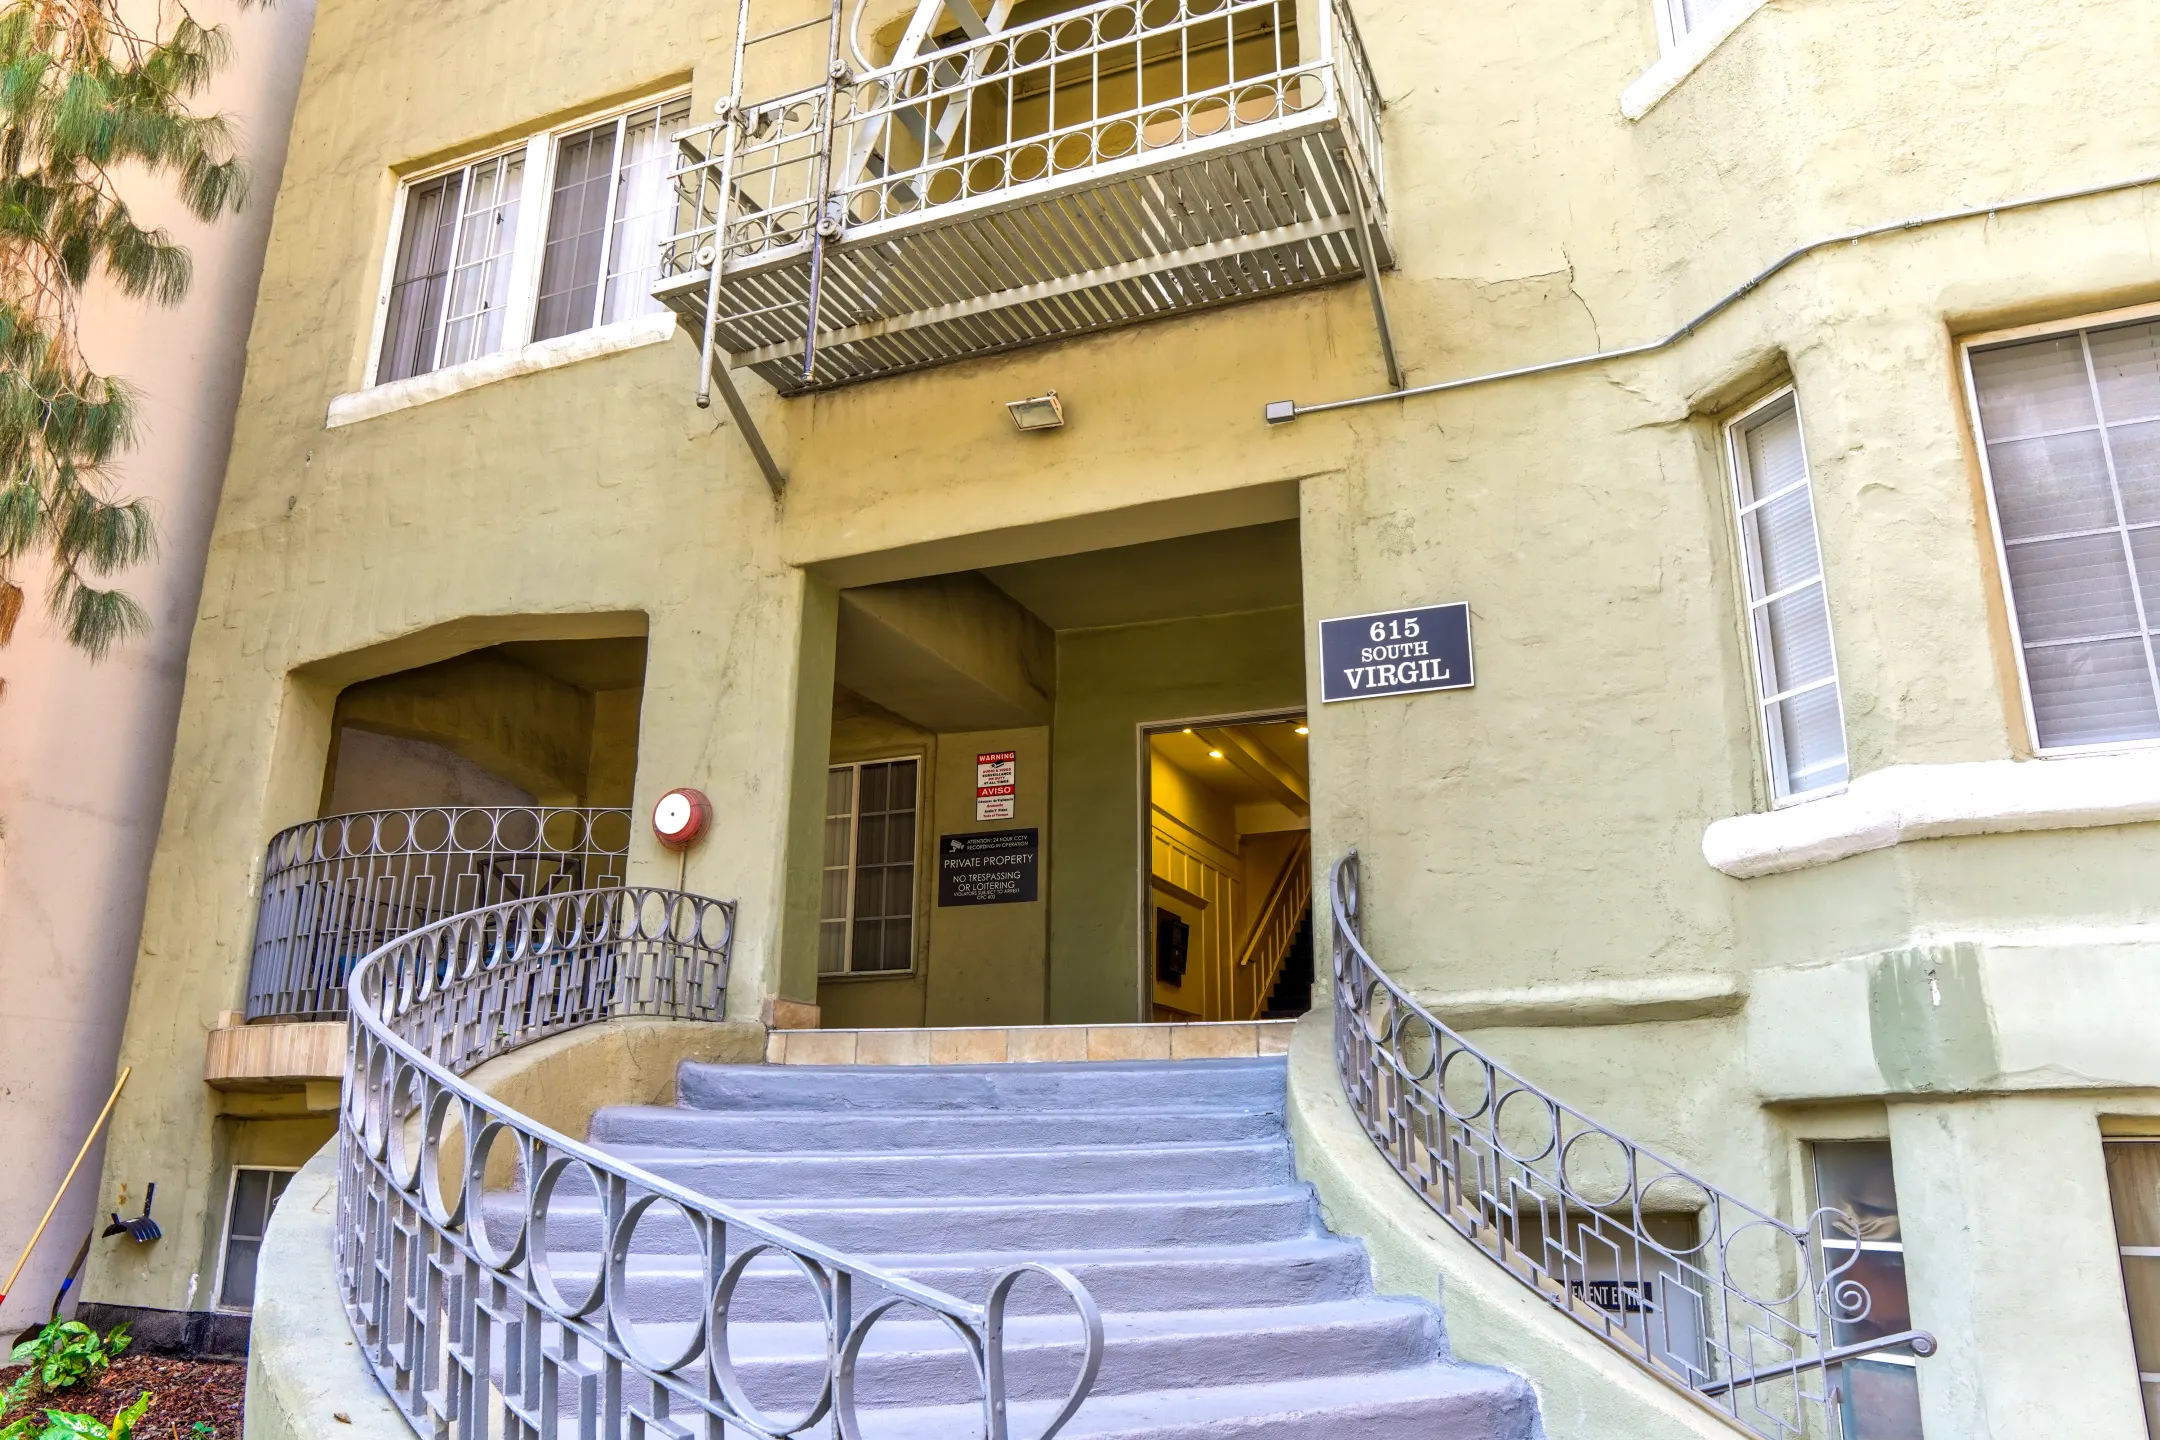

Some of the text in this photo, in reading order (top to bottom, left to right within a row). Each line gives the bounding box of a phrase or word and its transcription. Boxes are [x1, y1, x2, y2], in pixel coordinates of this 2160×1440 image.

[1370, 617, 1420, 642] 615
[1361, 641, 1429, 662] SOUTH
[1343, 658, 1450, 690] VIRGIL
[979, 753, 1015, 761] WARNING
[981, 787, 1011, 796] AVISO
[944, 853, 1034, 869] PRIVATE PROPERTY
[953, 871, 1021, 883] NO TRESPASSING
[958, 881, 1016, 892] OR LOITERING
